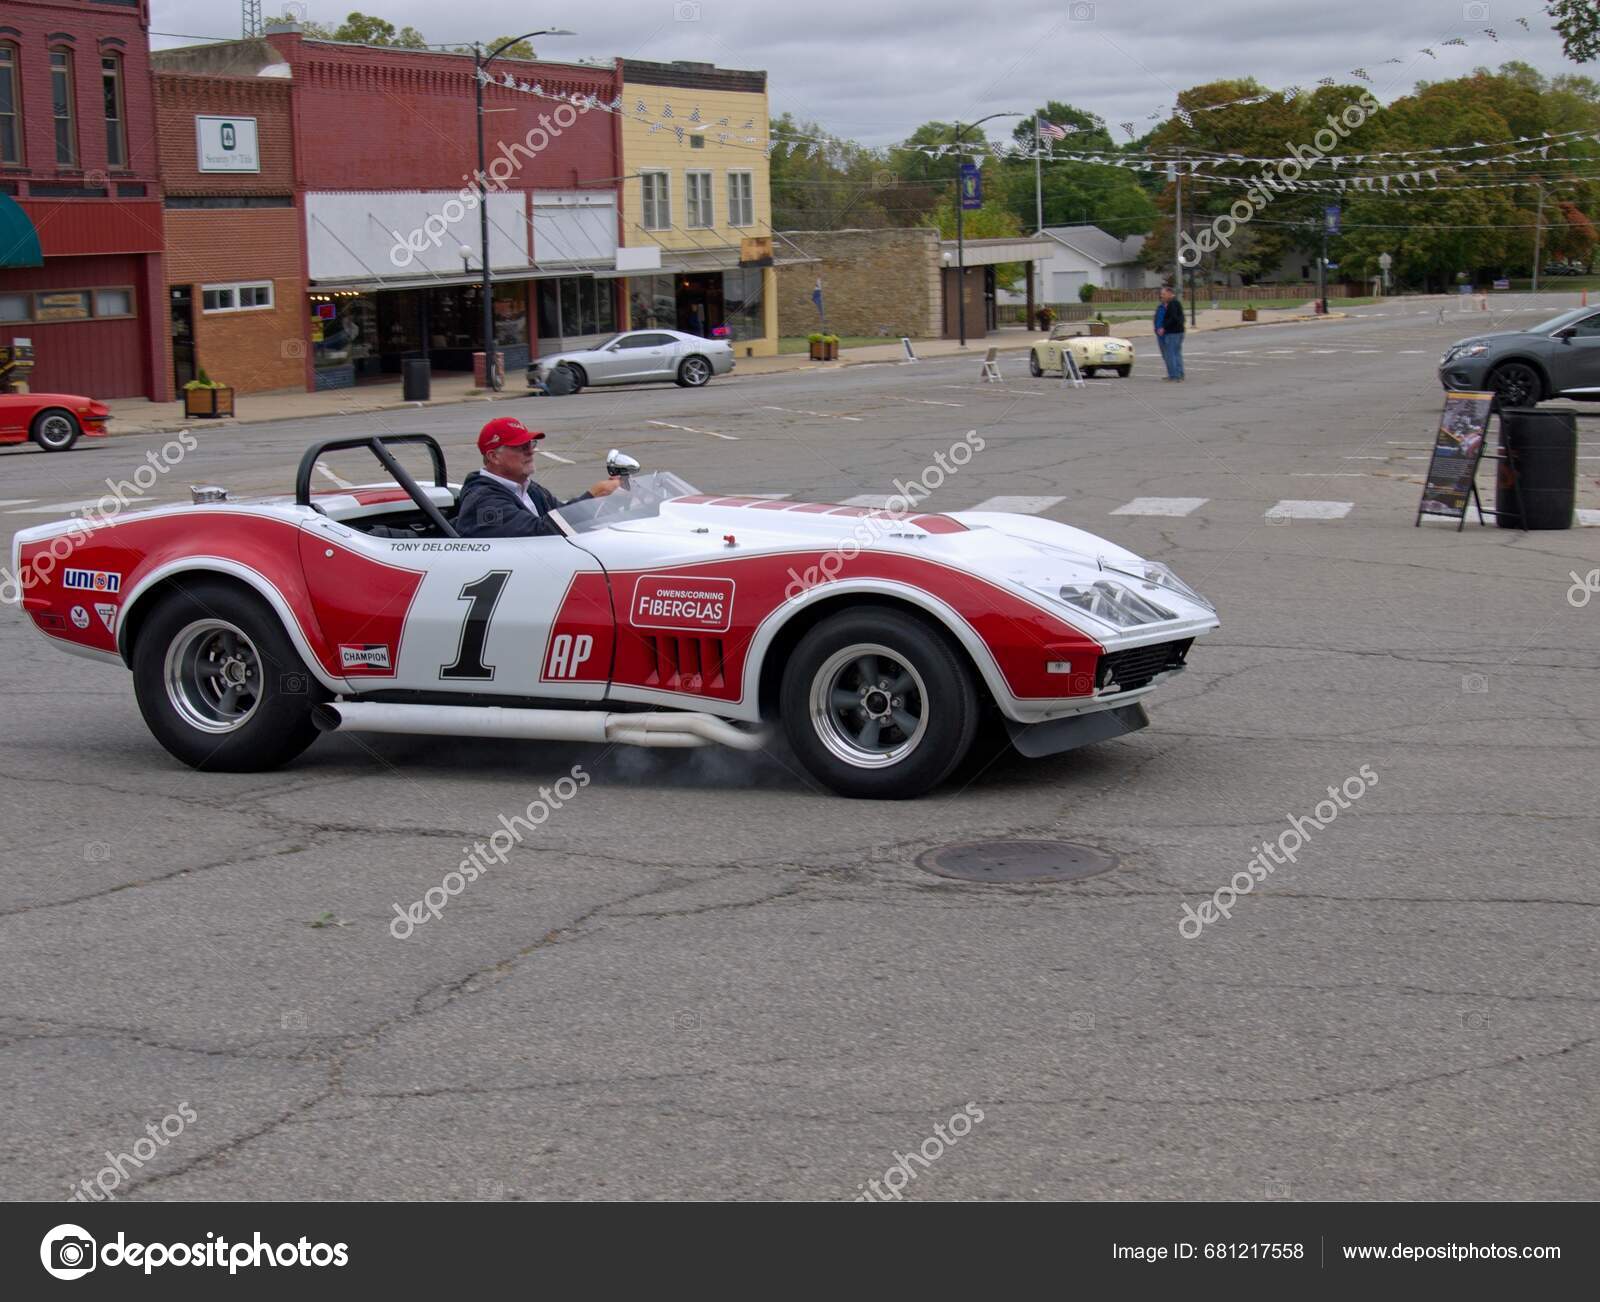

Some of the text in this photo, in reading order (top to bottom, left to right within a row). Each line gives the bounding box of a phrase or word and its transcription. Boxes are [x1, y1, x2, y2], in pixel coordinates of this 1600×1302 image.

[391, 543, 491, 552] TONY DELORENZO
[656, 589, 724, 600] OWENS/CORNING
[639, 597, 723, 620] FIBERGLAS
[439, 570, 513, 681] 1
[343, 651, 387, 662] CHAMPION
[548, 634, 594, 678] AP
